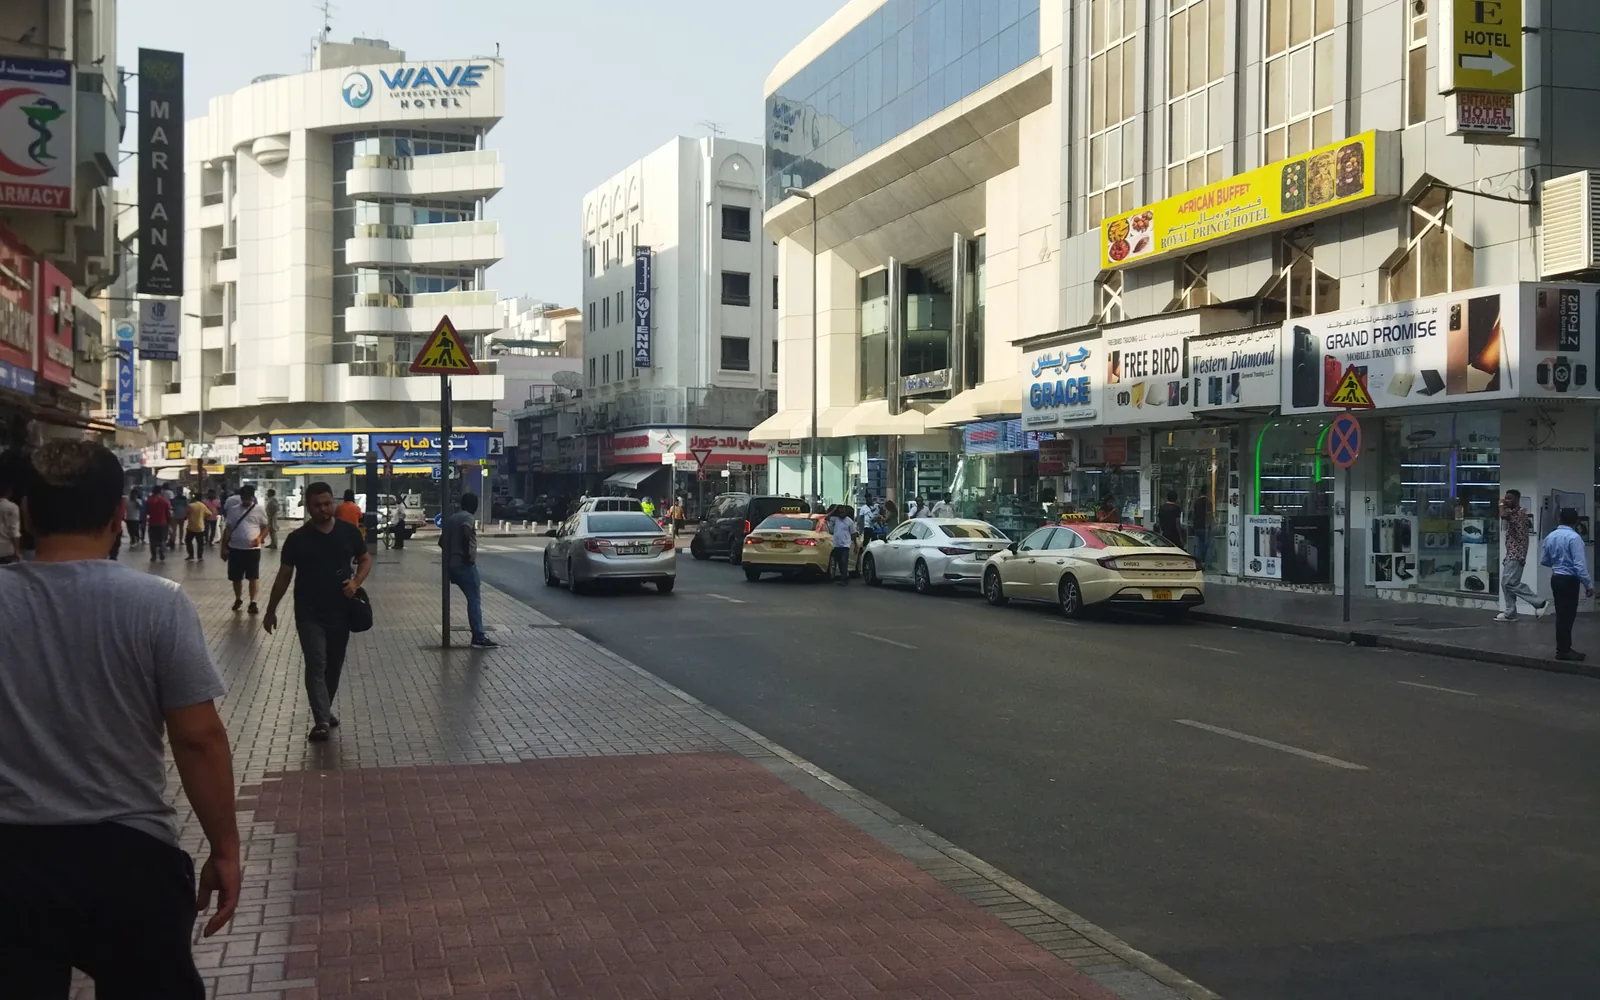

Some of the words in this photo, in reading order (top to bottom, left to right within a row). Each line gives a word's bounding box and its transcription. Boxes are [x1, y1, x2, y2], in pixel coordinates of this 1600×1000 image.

[1471, 0, 1502, 25] E
[1465, 31, 1511, 47] HOTEL
[380, 65, 489, 89] WAVE
[400, 98, 461, 109] HOTEL
[1460, 93, 1512, 108] ENTRANCE
[1461, 106, 1511, 119] HOTEL
[1461, 117, 1511, 126] RESTAURANT
[150, 99, 169, 272] MARIANA
[1178, 191, 1215, 214] AFRICAN
[1217, 184, 1251, 206] BUFFET
[1161, 231, 1190, 249] ROYAL
[1193, 218, 1231, 240] PRINCE
[1233, 207, 1270, 228] HOTEL
[1568, 295, 1578, 332] Fold2
[637, 311, 648, 356] VIENNA
[1326, 329, 1369, 350] GRAND
[1373, 320, 1437, 344] PROMISE
[1568, 336, 1578, 345] Z
[1032, 347, 1090, 378] جريس
[1124, 350, 1148, 378] FREE
[1152, 346, 1179, 375] BIRD
[1193, 355, 1228, 374] Western
[1230, 344, 1275, 370] Diamond
[1346, 351, 1371, 361] MOBILE
[1372, 347, 1400, 358] TRADING
[1402, 345, 1416, 355] EST.
[120, 359, 131, 402] AVE
[1030, 376, 1090, 409] GRACE
